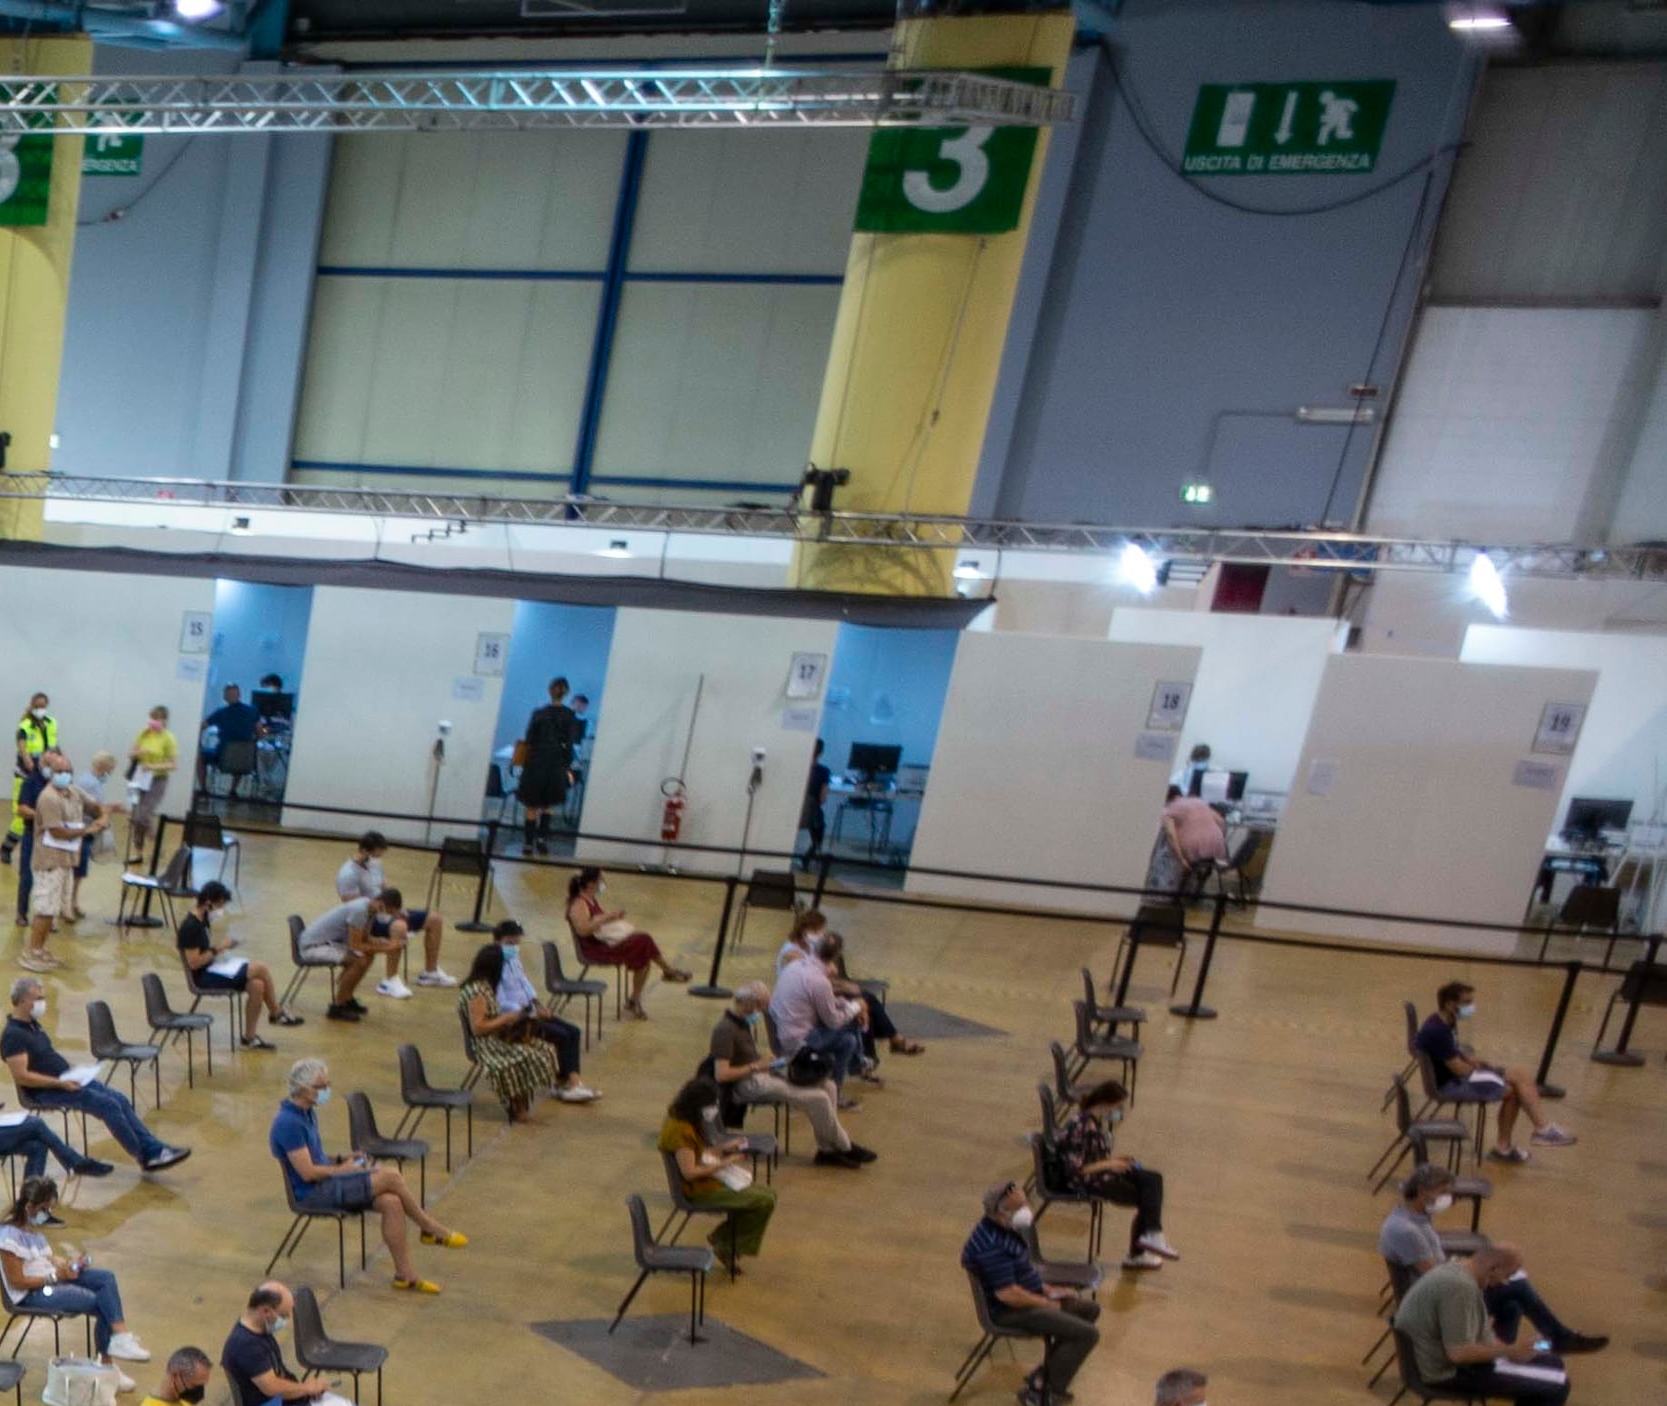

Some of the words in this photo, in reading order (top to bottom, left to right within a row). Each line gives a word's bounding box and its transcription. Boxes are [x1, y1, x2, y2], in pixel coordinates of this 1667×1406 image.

[81, 158, 138, 172] ERGENZA
[902, 108, 995, 213] 3
[1184, 155, 1242, 171] USCITA
[1246, 155, 1263, 170] DI
[1269, 153, 1371, 170] EMERGENZA
[800, 664, 816, 680] 17
[1162, 693, 1180, 710] 18
[1549, 713, 1571, 732] 19
